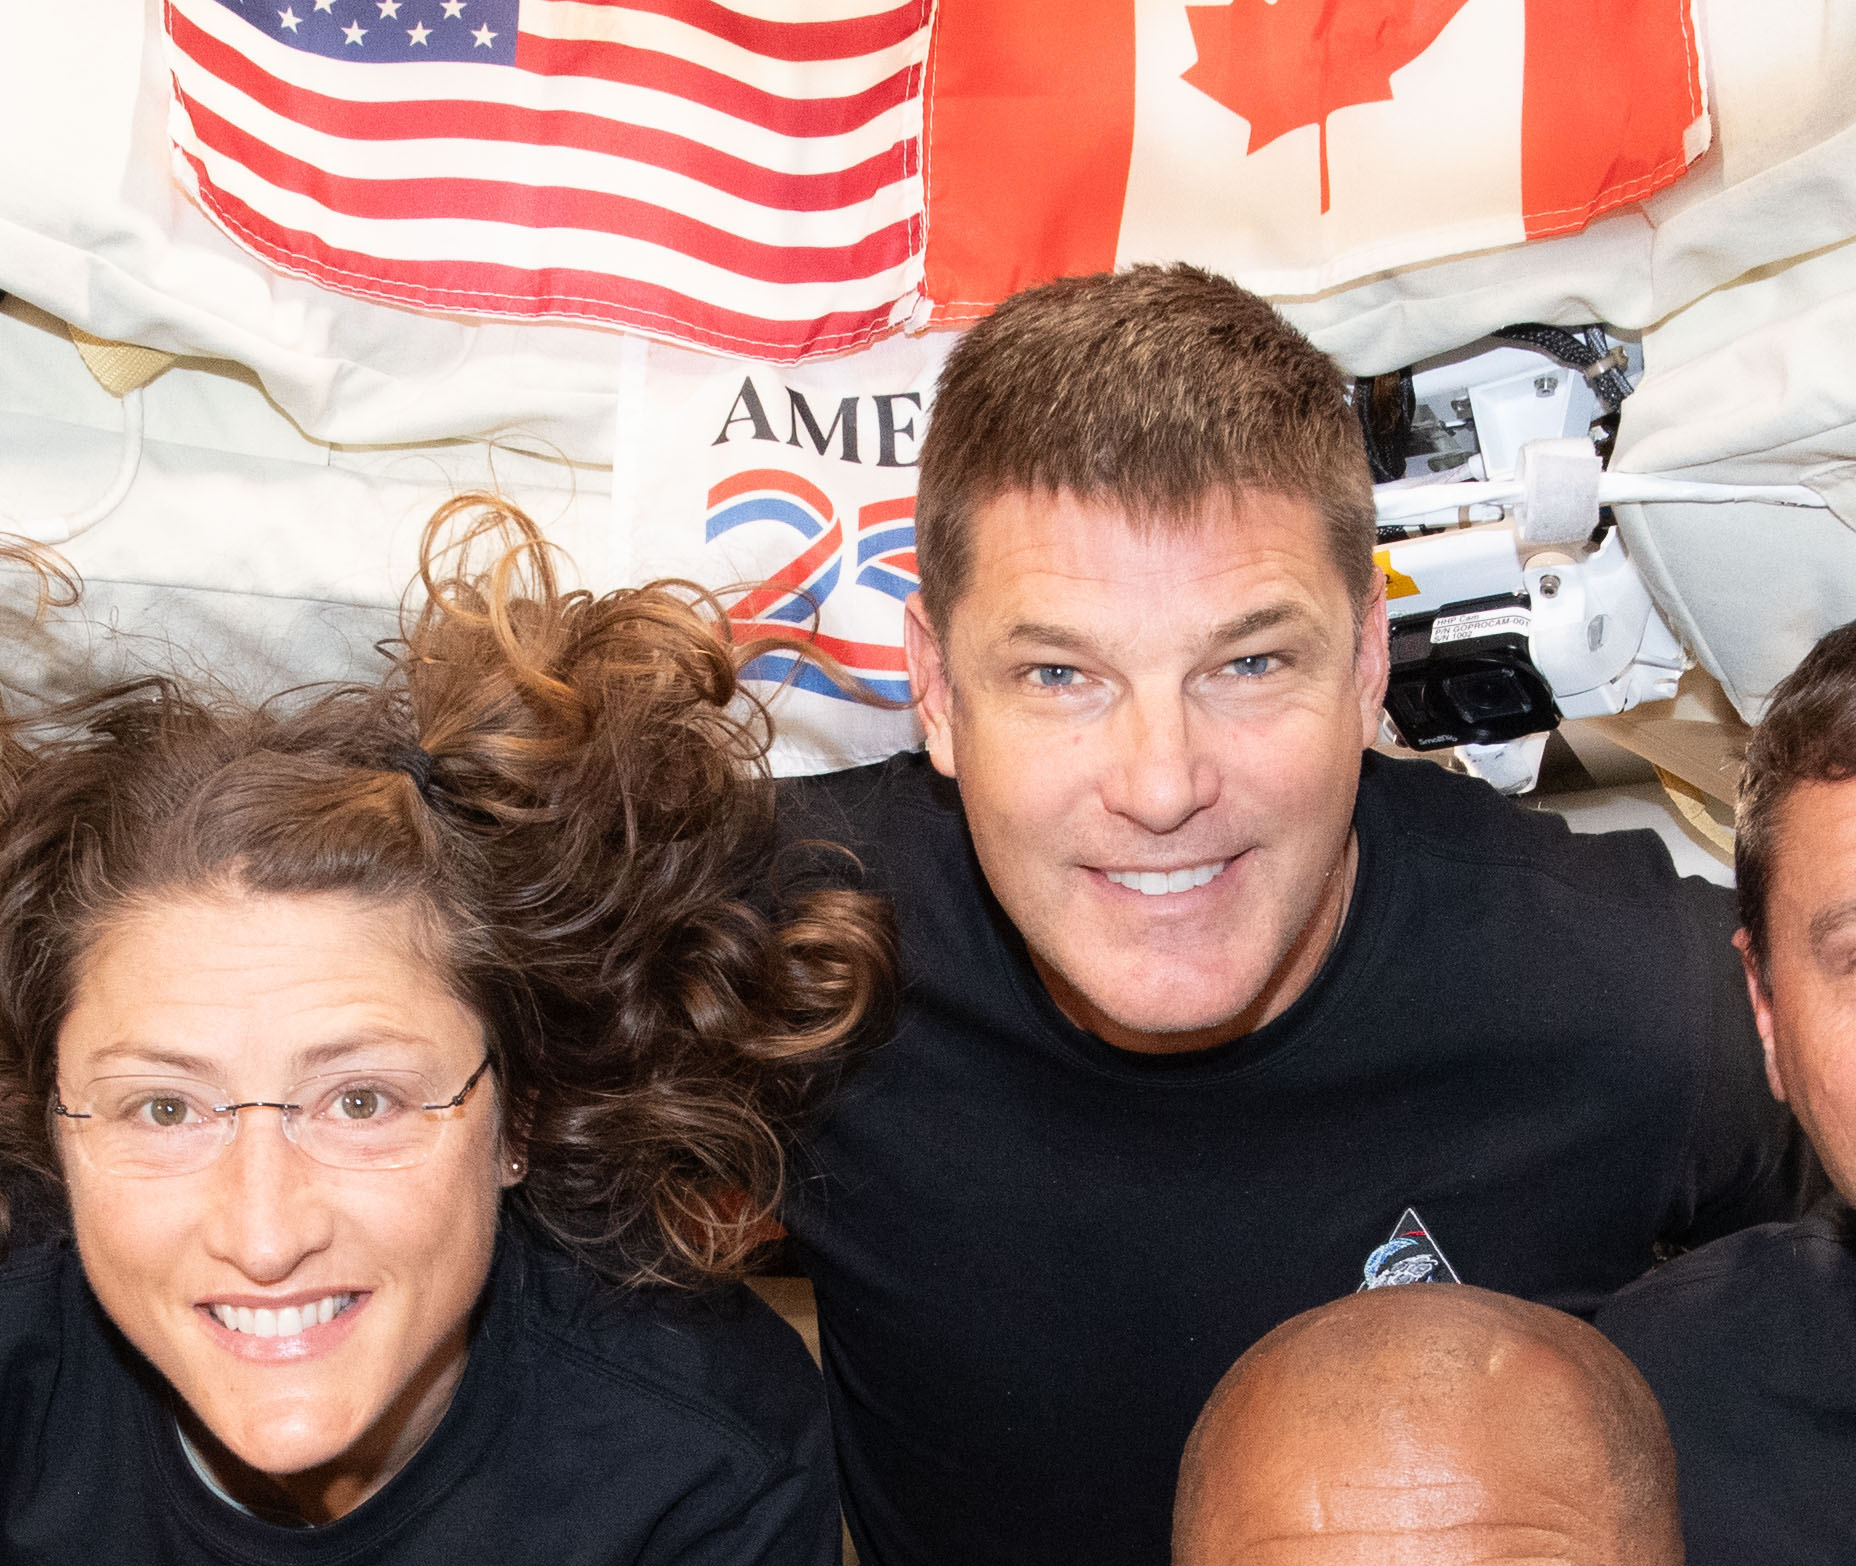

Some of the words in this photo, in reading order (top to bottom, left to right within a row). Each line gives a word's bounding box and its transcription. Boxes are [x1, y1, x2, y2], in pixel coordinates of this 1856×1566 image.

[1437, 616, 1457, 627] HHP
[1460, 613, 1480, 622] Cam
[1434, 635, 1450, 644] S/N
[1452, 630, 1473, 640] 1002
[1435, 626, 1450, 636] P/N
